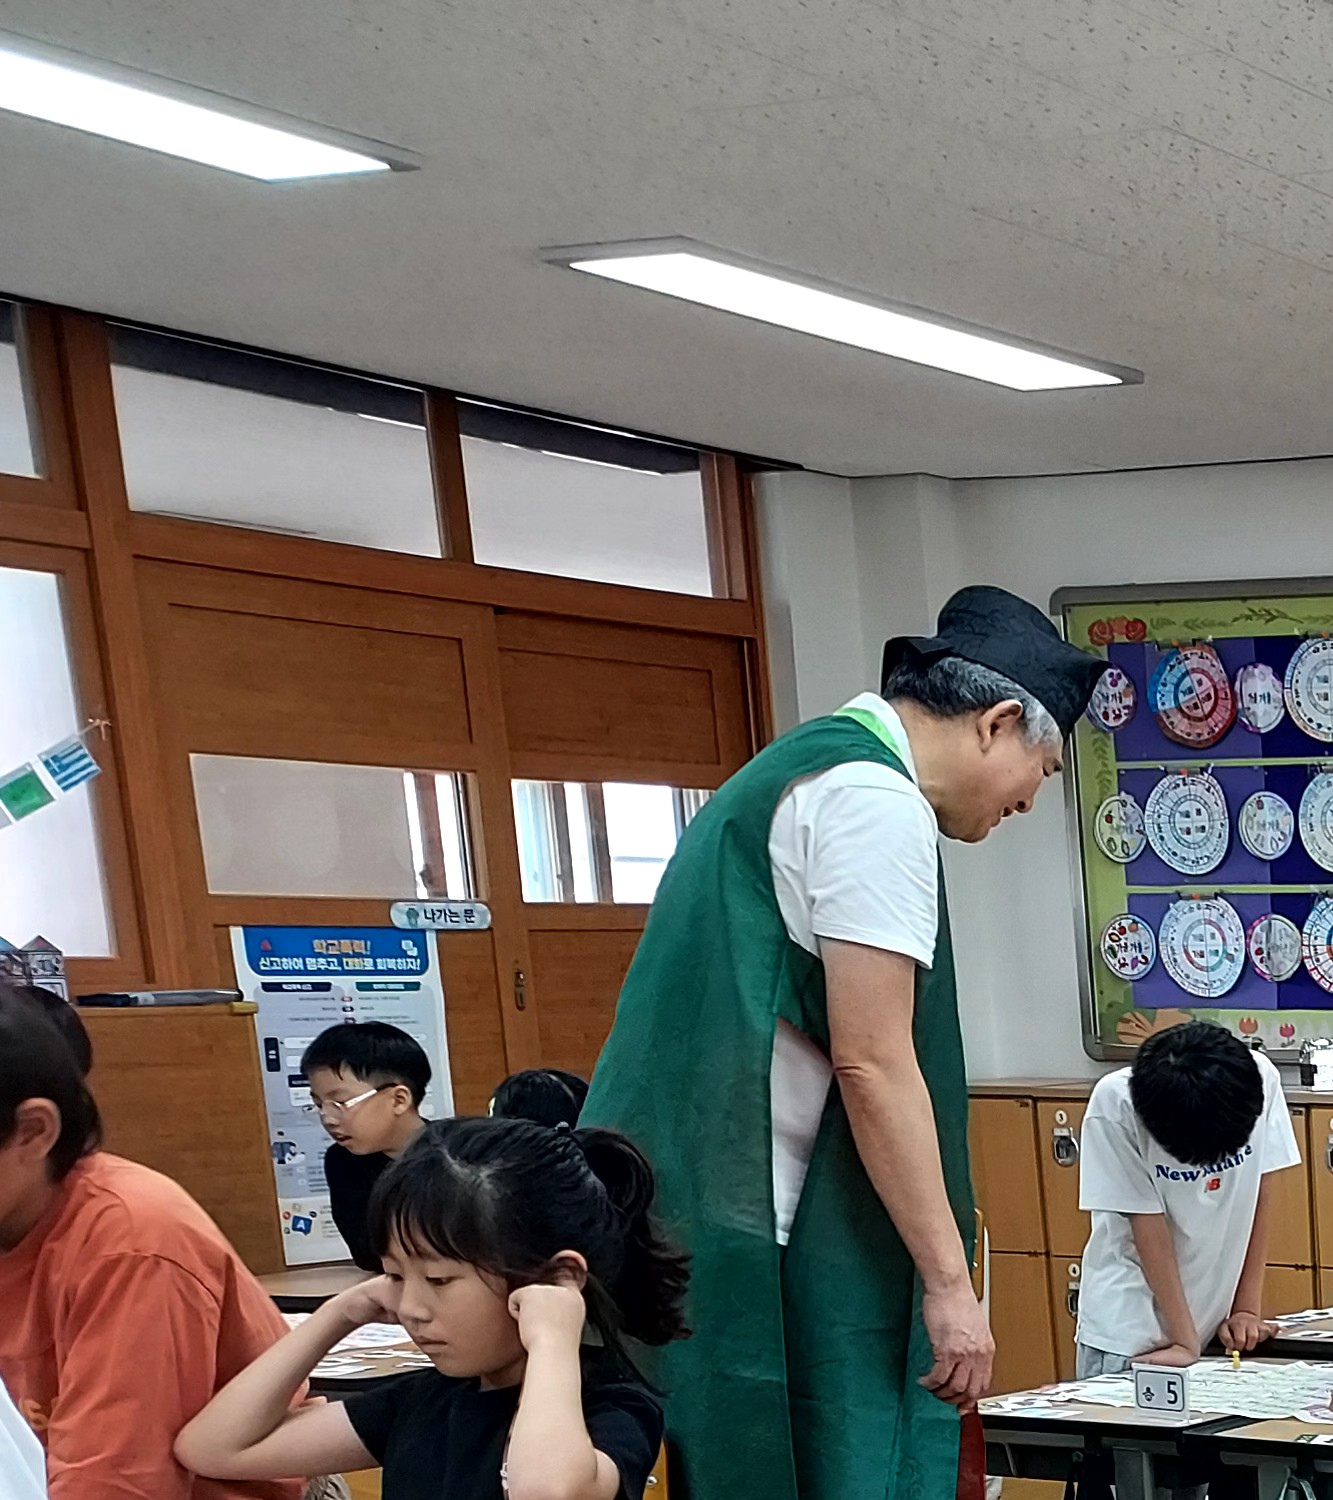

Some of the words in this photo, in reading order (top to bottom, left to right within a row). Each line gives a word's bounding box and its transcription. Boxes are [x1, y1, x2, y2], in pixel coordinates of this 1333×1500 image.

[423, 908, 460, 923] 나가는
[463, 909, 476, 924] 문
[313, 939, 371, 955] 학교폭력!
[259, 957, 304, 970] 신고하여
[306, 957, 341, 971] 멈추고,
[343, 957, 375, 971] 대화로
[1155, 1165, 1200, 1182] New
[1167, 1381, 1178, 1404] 5
